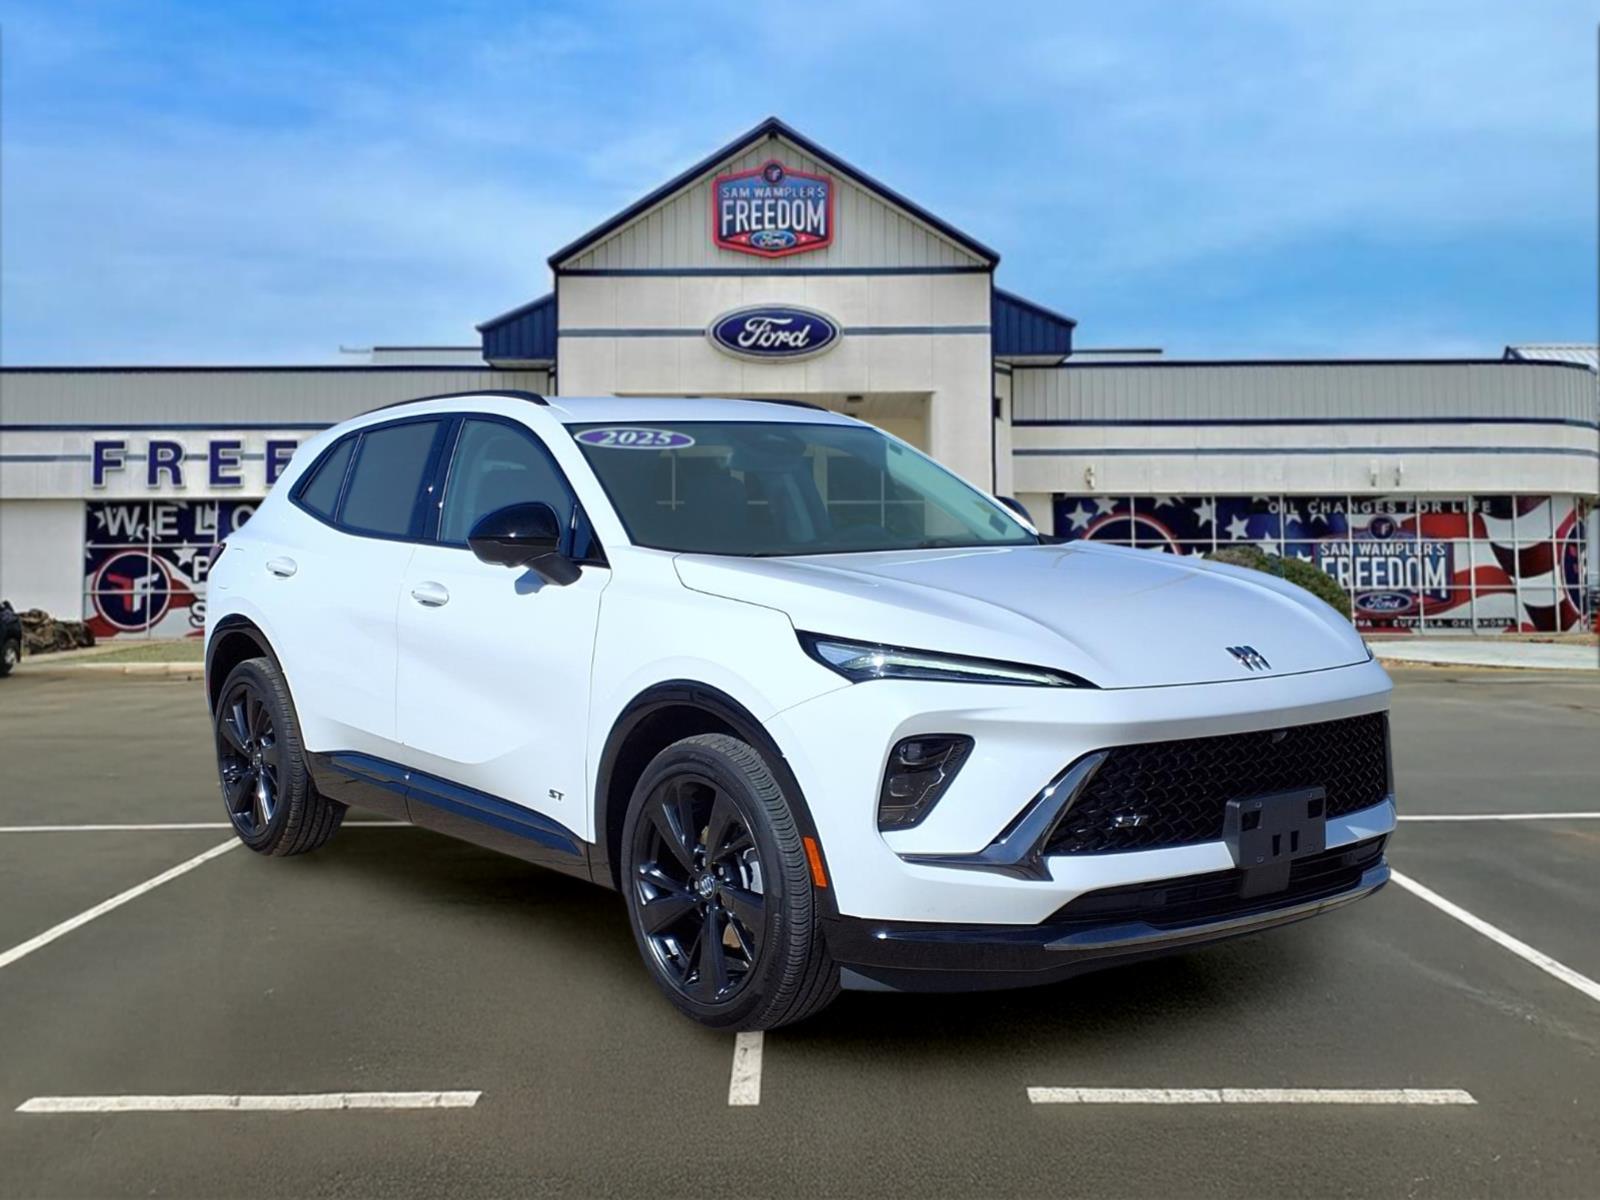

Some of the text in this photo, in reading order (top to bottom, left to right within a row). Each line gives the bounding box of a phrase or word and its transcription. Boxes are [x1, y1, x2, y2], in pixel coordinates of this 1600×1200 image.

[722, 187, 750, 198] SAM
[721, 199, 825, 236] FREEDOM
[758, 231, 787, 247] Ford
[738, 316, 811, 347] Ford
[597, 430, 674, 446] 2025
[1267, 500, 1492, 514] OIL CHANGES FOR LIFE
[1364, 595, 1401, 610] Ford
[548, 788, 565, 801] ST
